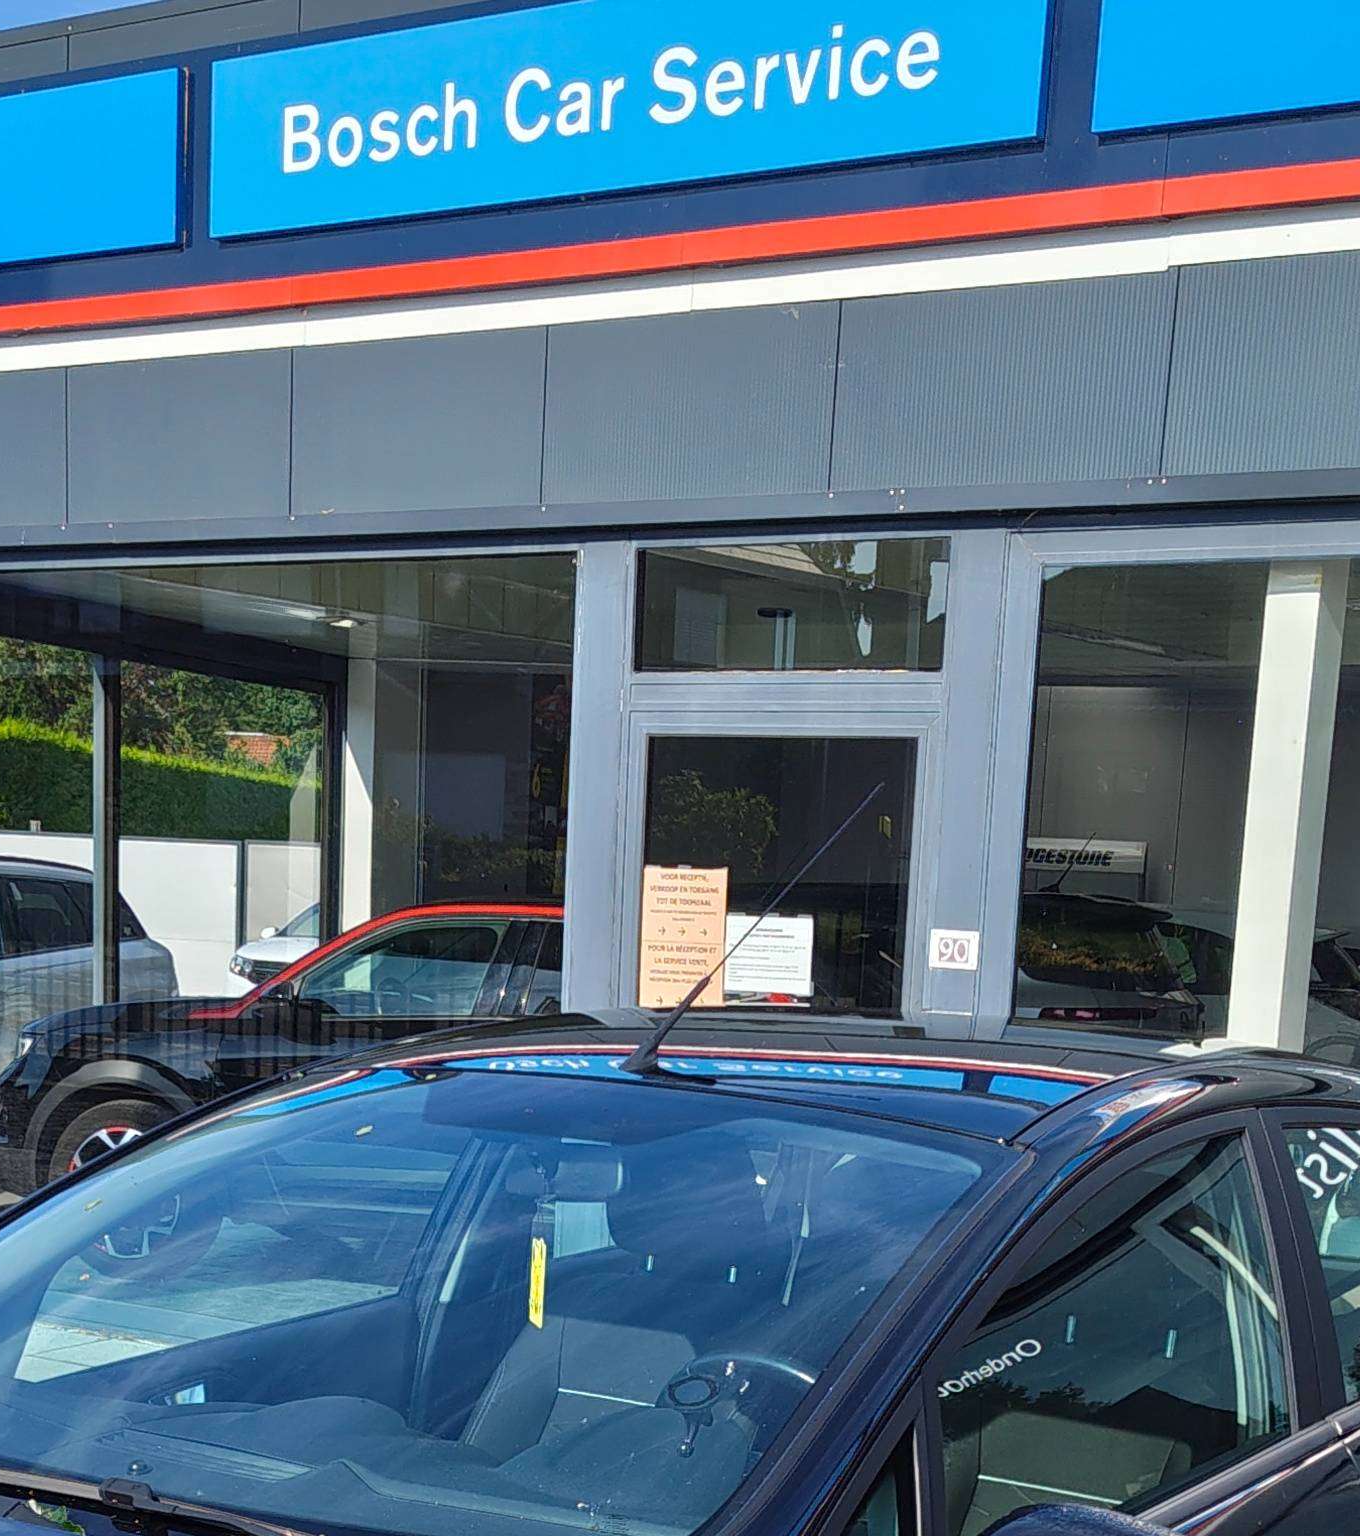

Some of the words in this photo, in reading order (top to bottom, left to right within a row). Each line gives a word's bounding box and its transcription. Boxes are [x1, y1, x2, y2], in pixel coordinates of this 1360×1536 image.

[282, 82, 478, 173] Bosch
[505, 68, 625, 142] Car
[648, 24, 941, 124] Service
[938, 937, 970, 963] 90
